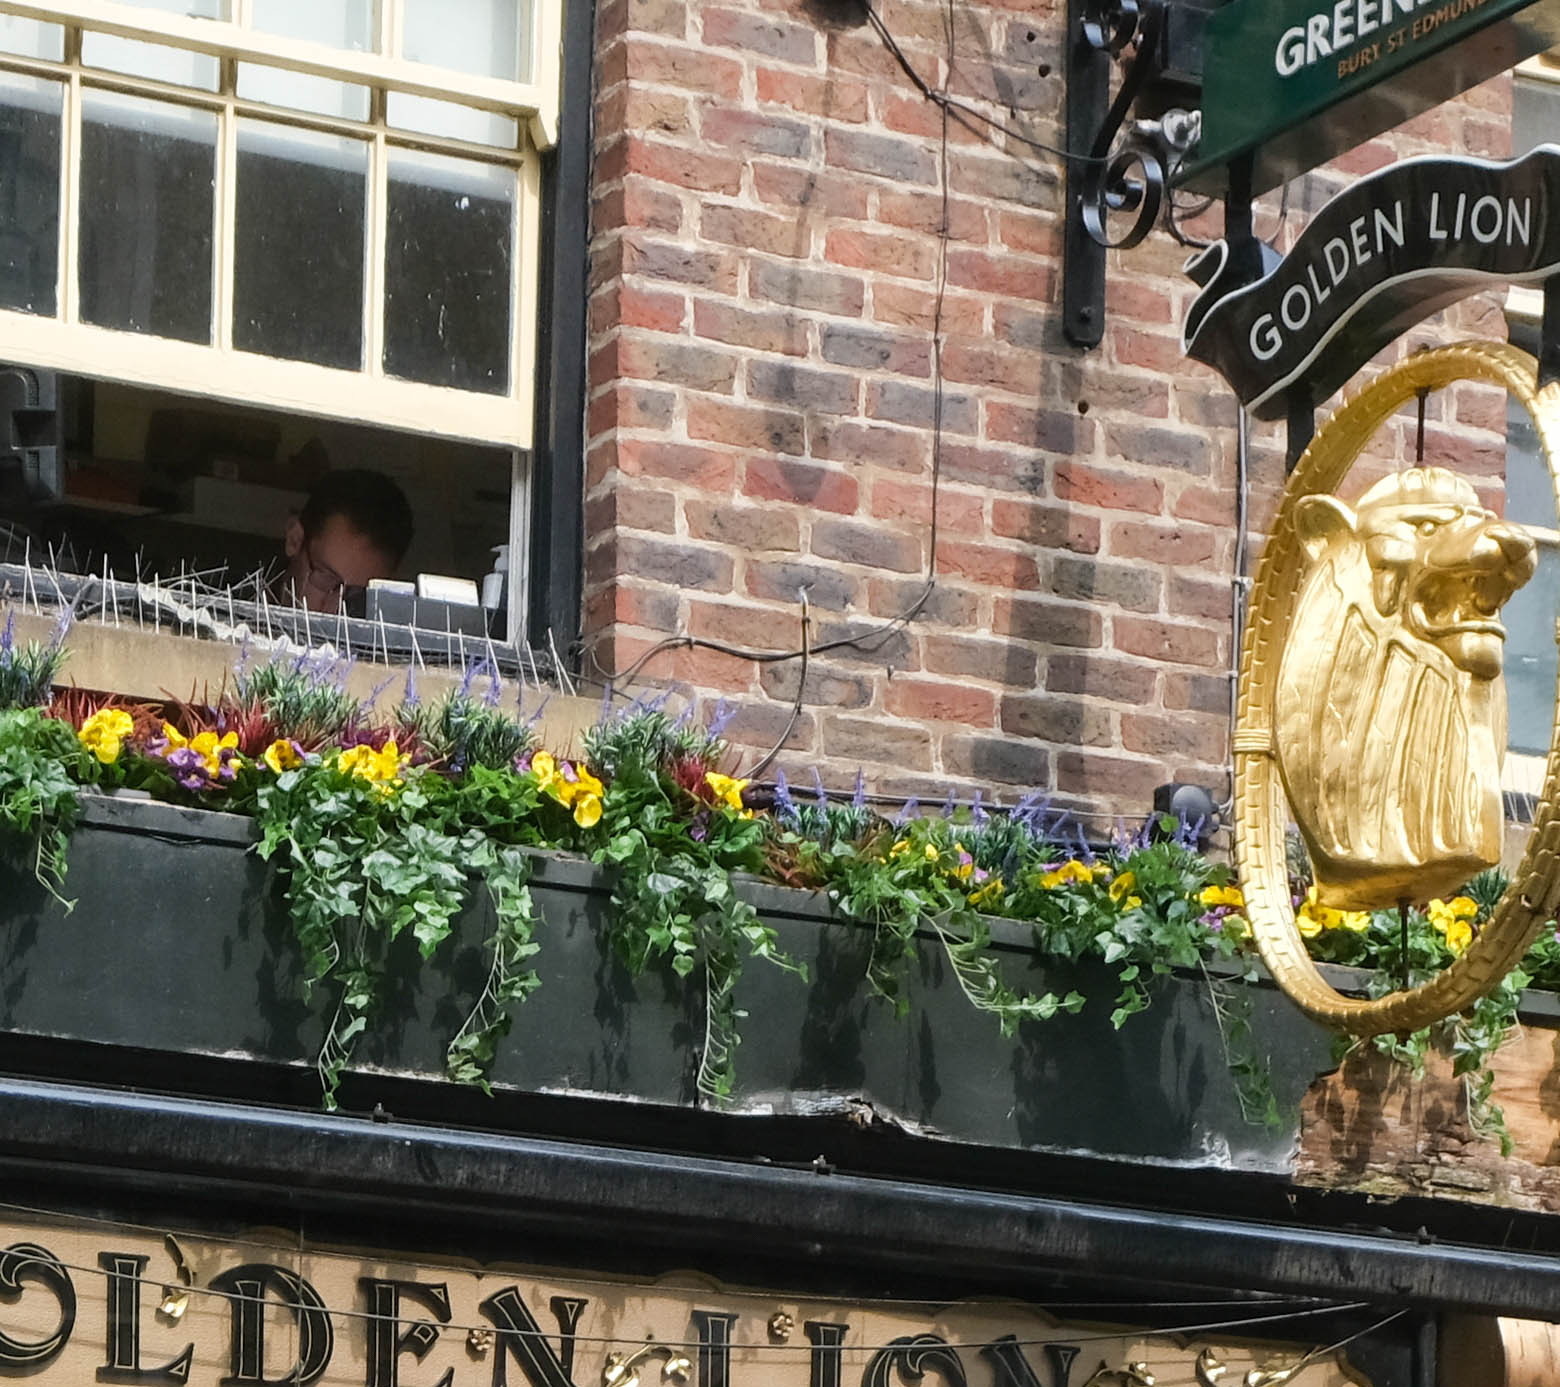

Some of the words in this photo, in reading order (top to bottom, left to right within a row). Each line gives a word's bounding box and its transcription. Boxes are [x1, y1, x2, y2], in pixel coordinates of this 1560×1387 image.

[1275, 0, 1428, 76] GREEN
[1338, 43, 1379, 79] BURY
[1387, 27, 1406, 53] ST
[1412, 0, 1486, 41] EDMUN
[1249, 200, 1405, 361] GOLDEN
[1428, 192, 1532, 247] LION
